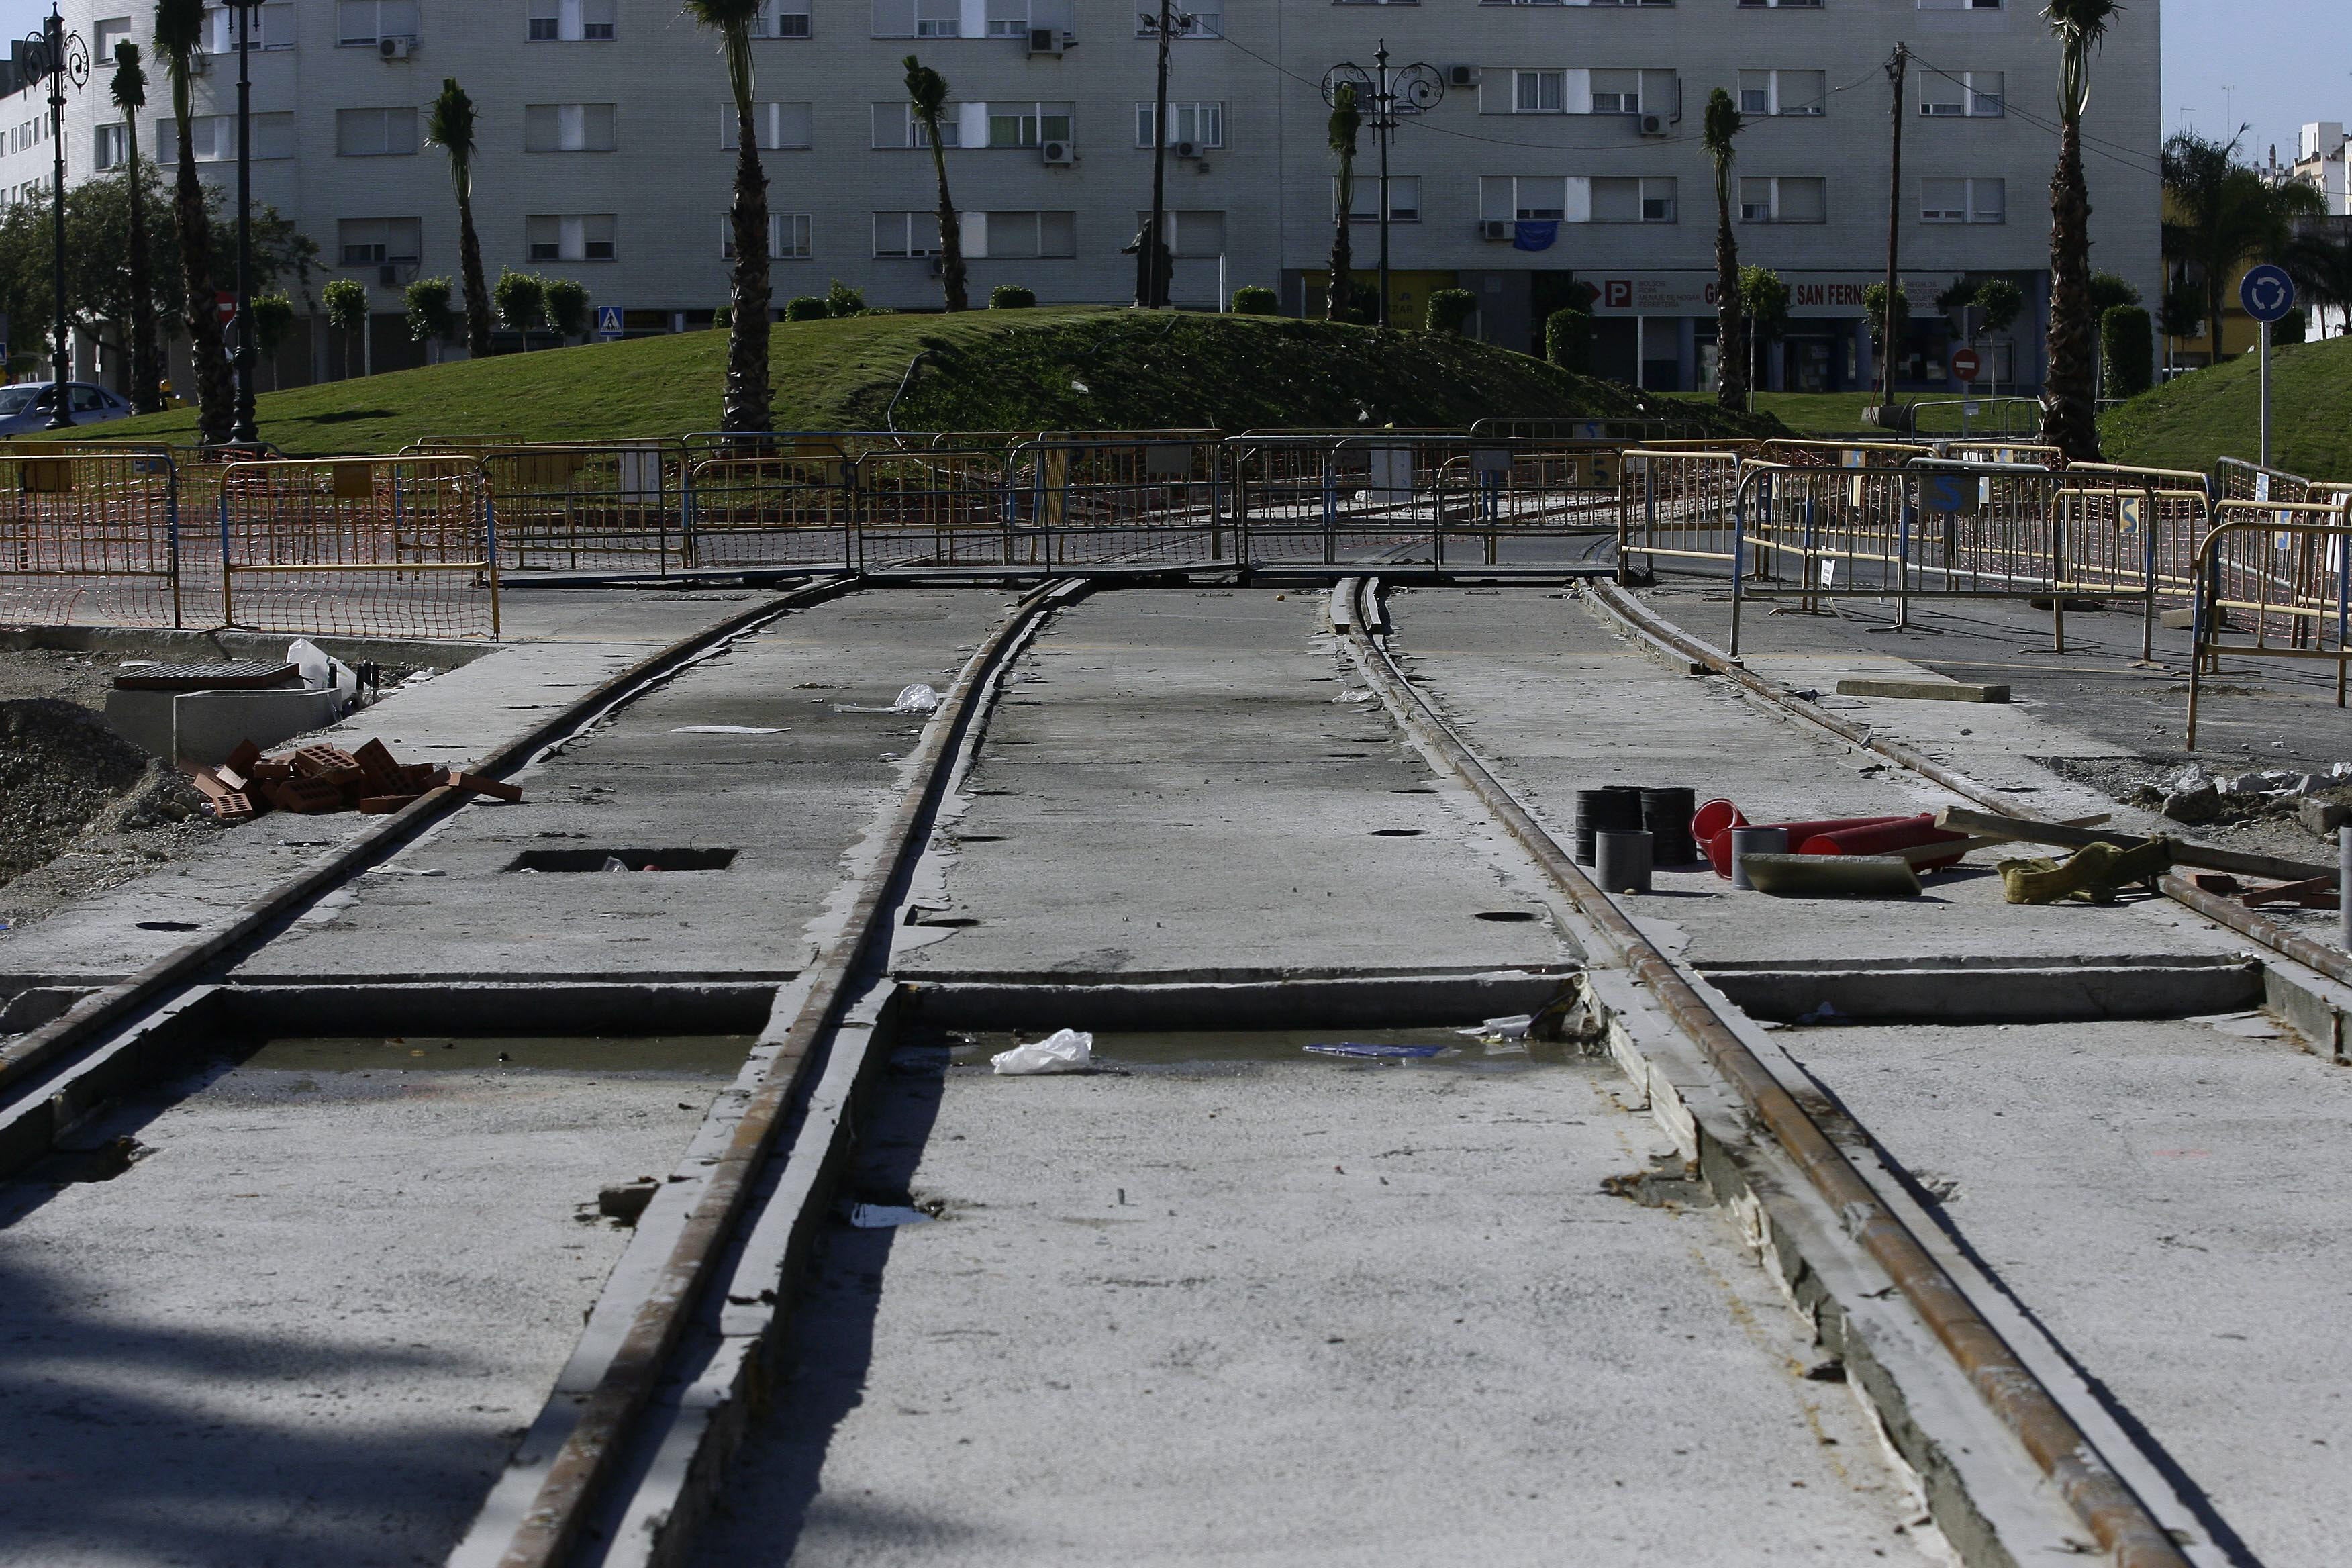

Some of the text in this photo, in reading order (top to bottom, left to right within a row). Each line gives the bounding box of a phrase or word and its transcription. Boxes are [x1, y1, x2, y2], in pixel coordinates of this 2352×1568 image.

[1610, 283, 1628, 305] P
[1798, 284, 1824, 305] SAN
[2122, 499, 2137, 534] S
